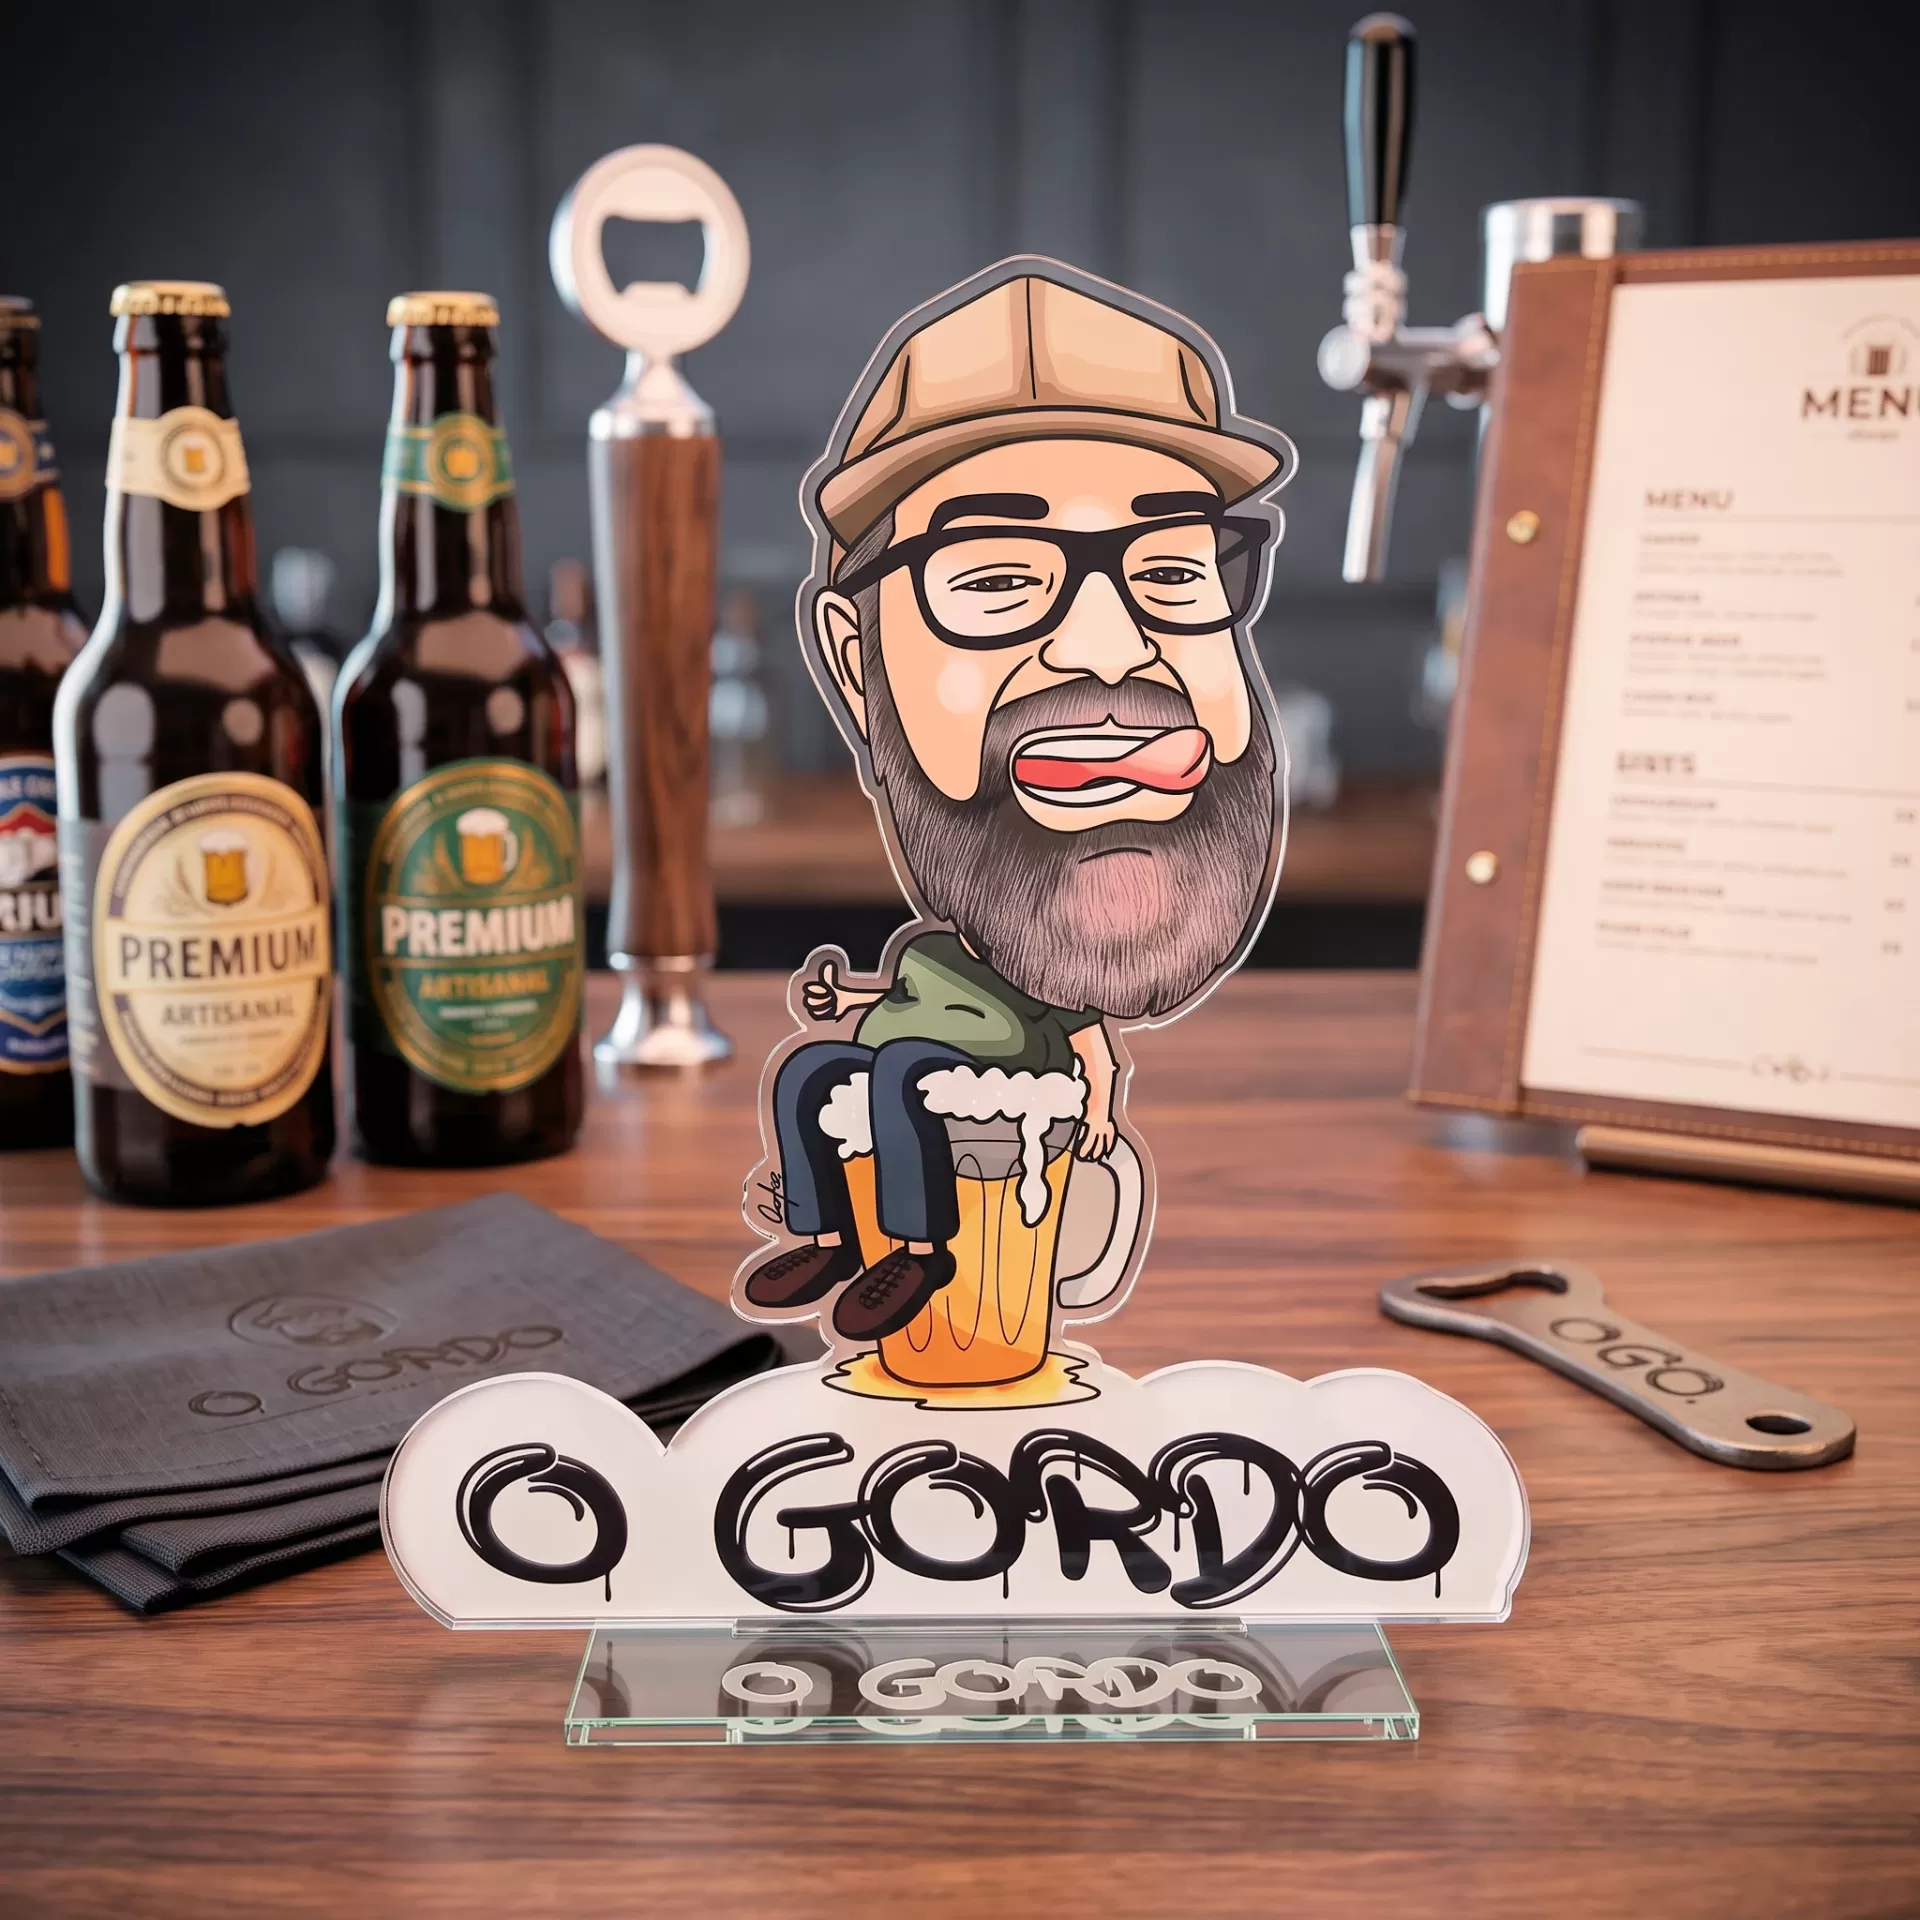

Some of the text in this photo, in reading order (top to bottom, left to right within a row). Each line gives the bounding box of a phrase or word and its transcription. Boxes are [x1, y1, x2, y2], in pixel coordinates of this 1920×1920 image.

[1802, 386, 1920, 419] MEN
[119, 925, 319, 980] PREMIUM
[381, 896, 574, 958] PREMIUM
[287, 1325, 563, 1397] GORDO
[456, 1428, 1460, 1613] O GORDO
